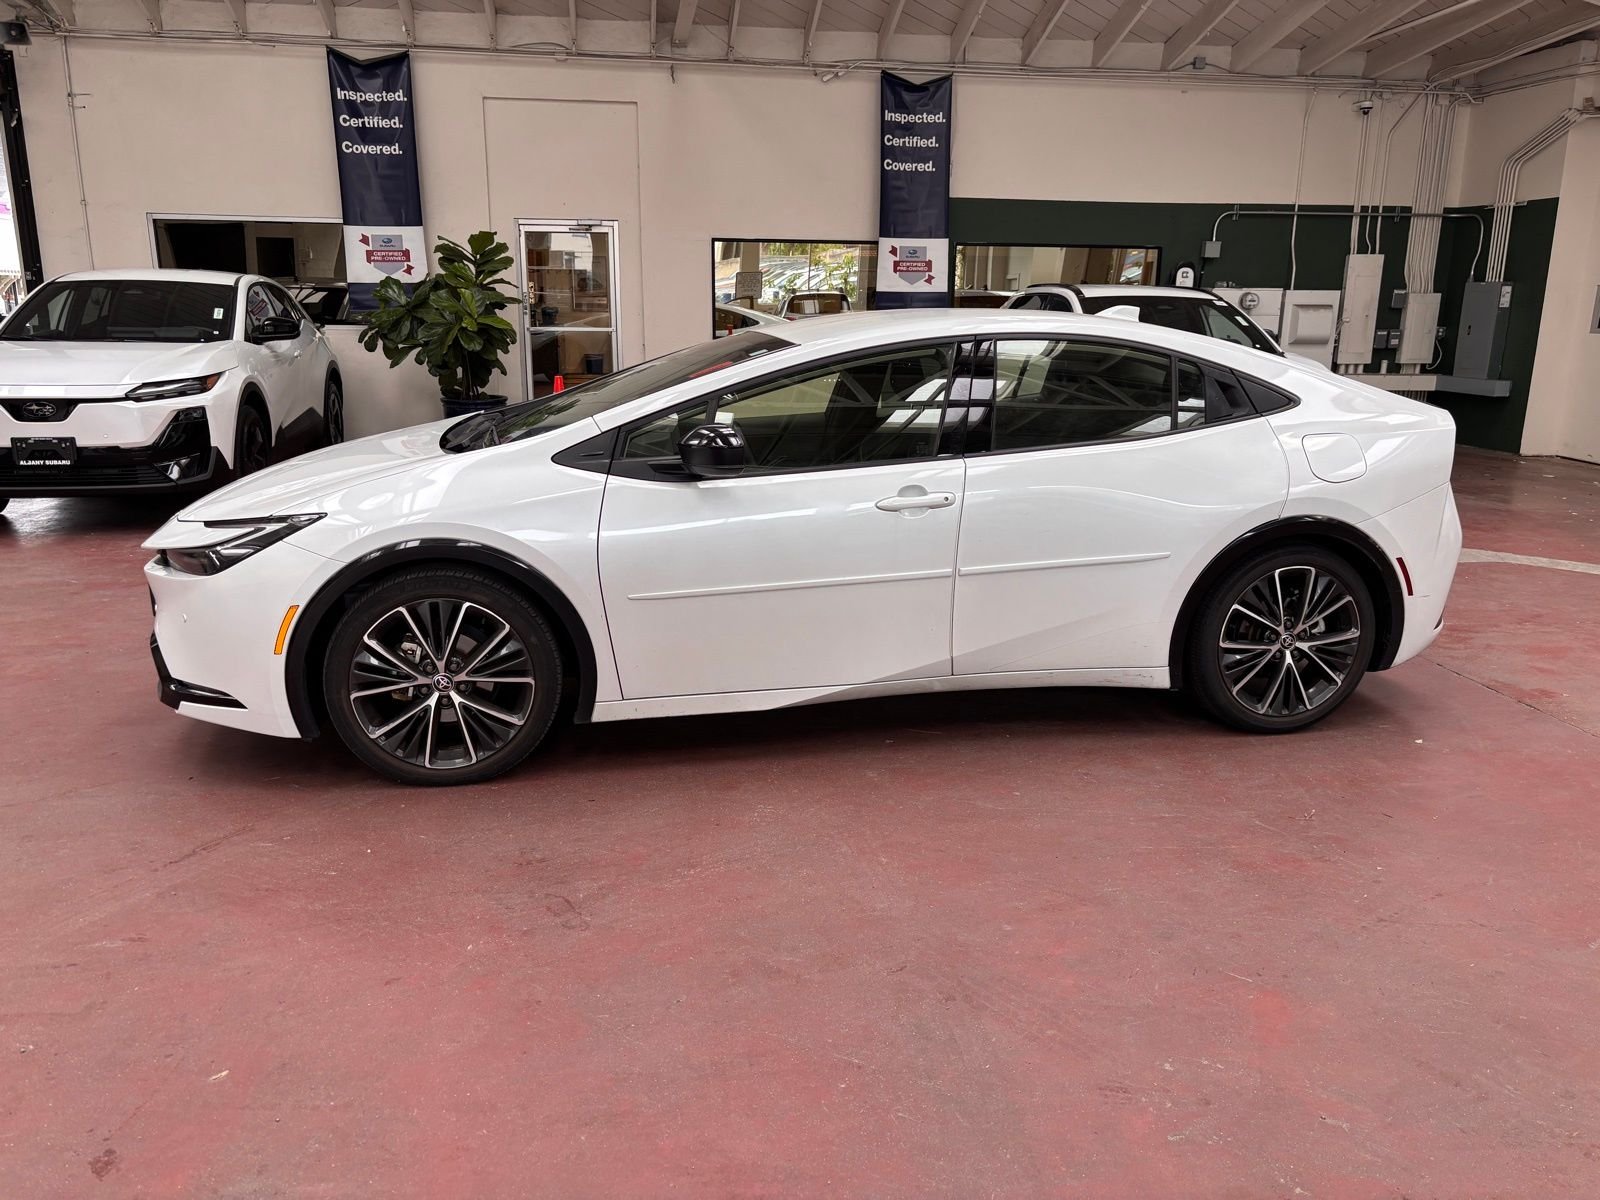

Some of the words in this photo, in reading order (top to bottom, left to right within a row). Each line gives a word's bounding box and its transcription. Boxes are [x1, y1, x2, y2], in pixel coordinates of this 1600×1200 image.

[336, 87, 408, 103] Inspected.
[339, 114, 404, 129] Certified.
[884, 109, 946, 125] Inspected.
[341, 140, 403, 155] Covered.
[884, 134, 939, 148] Certified.
[883, 158, 936, 172] Covered.
